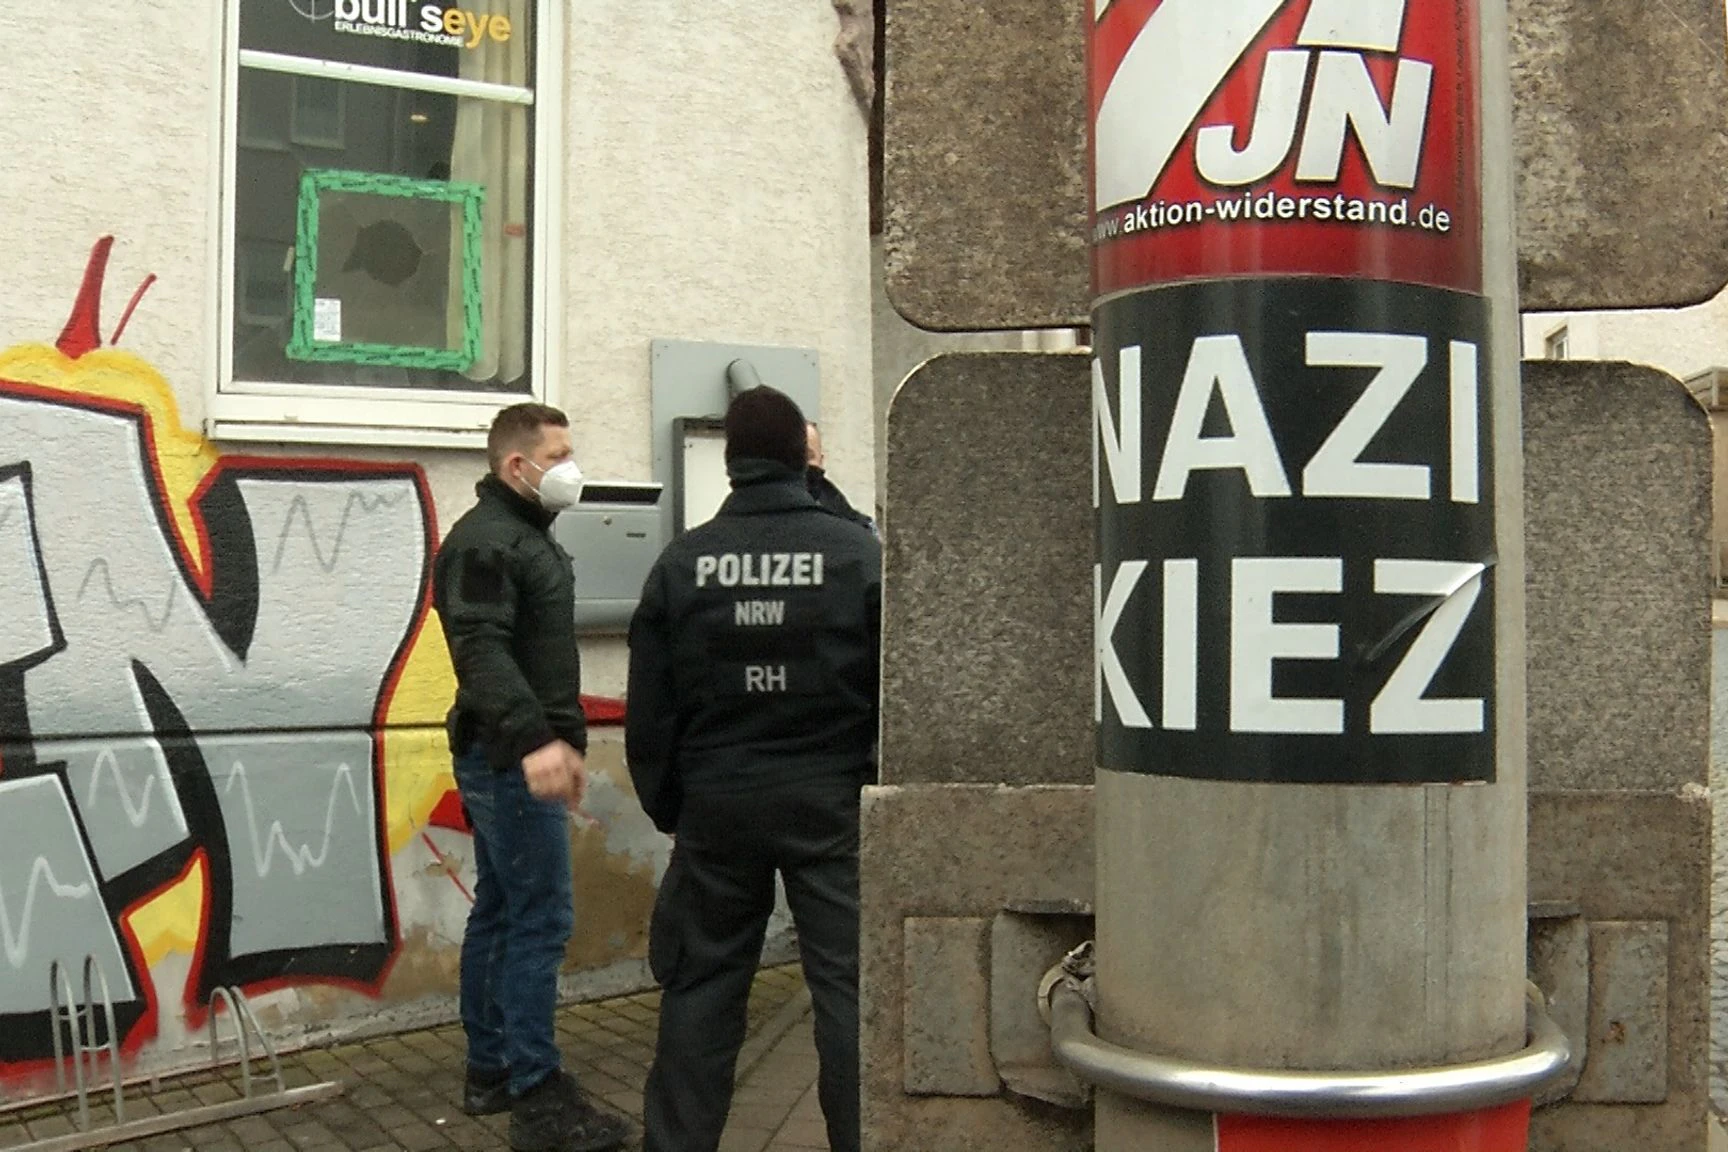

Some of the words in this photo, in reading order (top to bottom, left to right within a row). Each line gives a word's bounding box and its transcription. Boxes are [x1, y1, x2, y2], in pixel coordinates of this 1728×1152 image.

[1195, 49, 1433, 188] JN
[1092, 331, 1479, 508] NAZI
[696, 552, 824, 587] POLIZEI
[734, 600, 785, 626] NRW
[744, 664, 787, 692] RH
[1094, 557, 1485, 734] KIEZ
